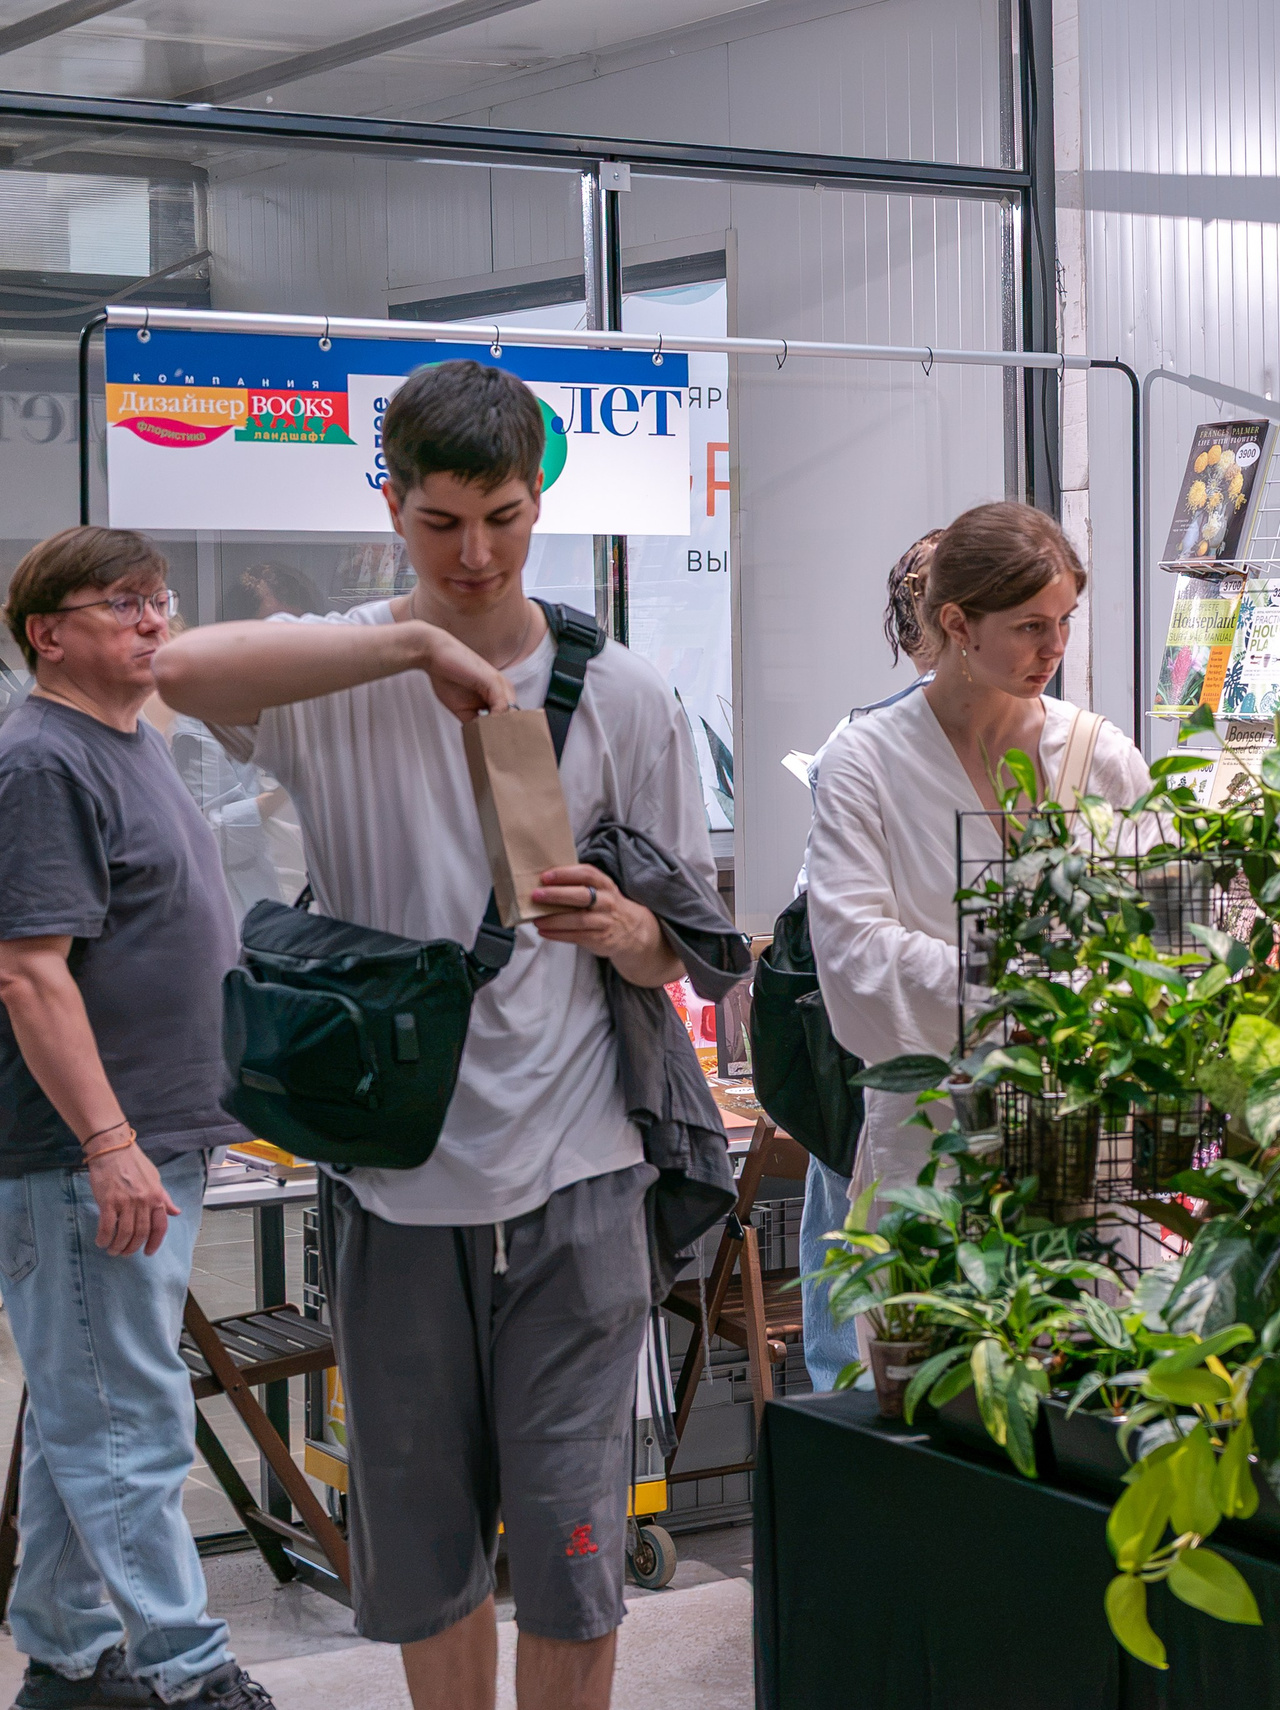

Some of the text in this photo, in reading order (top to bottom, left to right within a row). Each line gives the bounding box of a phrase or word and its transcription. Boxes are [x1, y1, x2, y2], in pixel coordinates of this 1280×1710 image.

[133, 373, 320, 389] КОМПАНИЯ
[118, 391, 245, 420] Дизайнер
[689, 387, 728, 409] ЯР
[251, 396, 334, 418] BOOKS
[551, 386, 682, 437] лет
[136, 420, 206, 442] флористика
[254, 430, 326, 443] ландшафт
[1199, 426, 1259, 438] FRANCES PALMER
[1238, 448, 1257, 459] 3900
[1223, 580, 1242, 591] 3700
[1171, 611, 1236, 632] Houseplant
[1204, 632, 1232, 641] MANUAL
[1228, 726, 1267, 743] Bonsai
